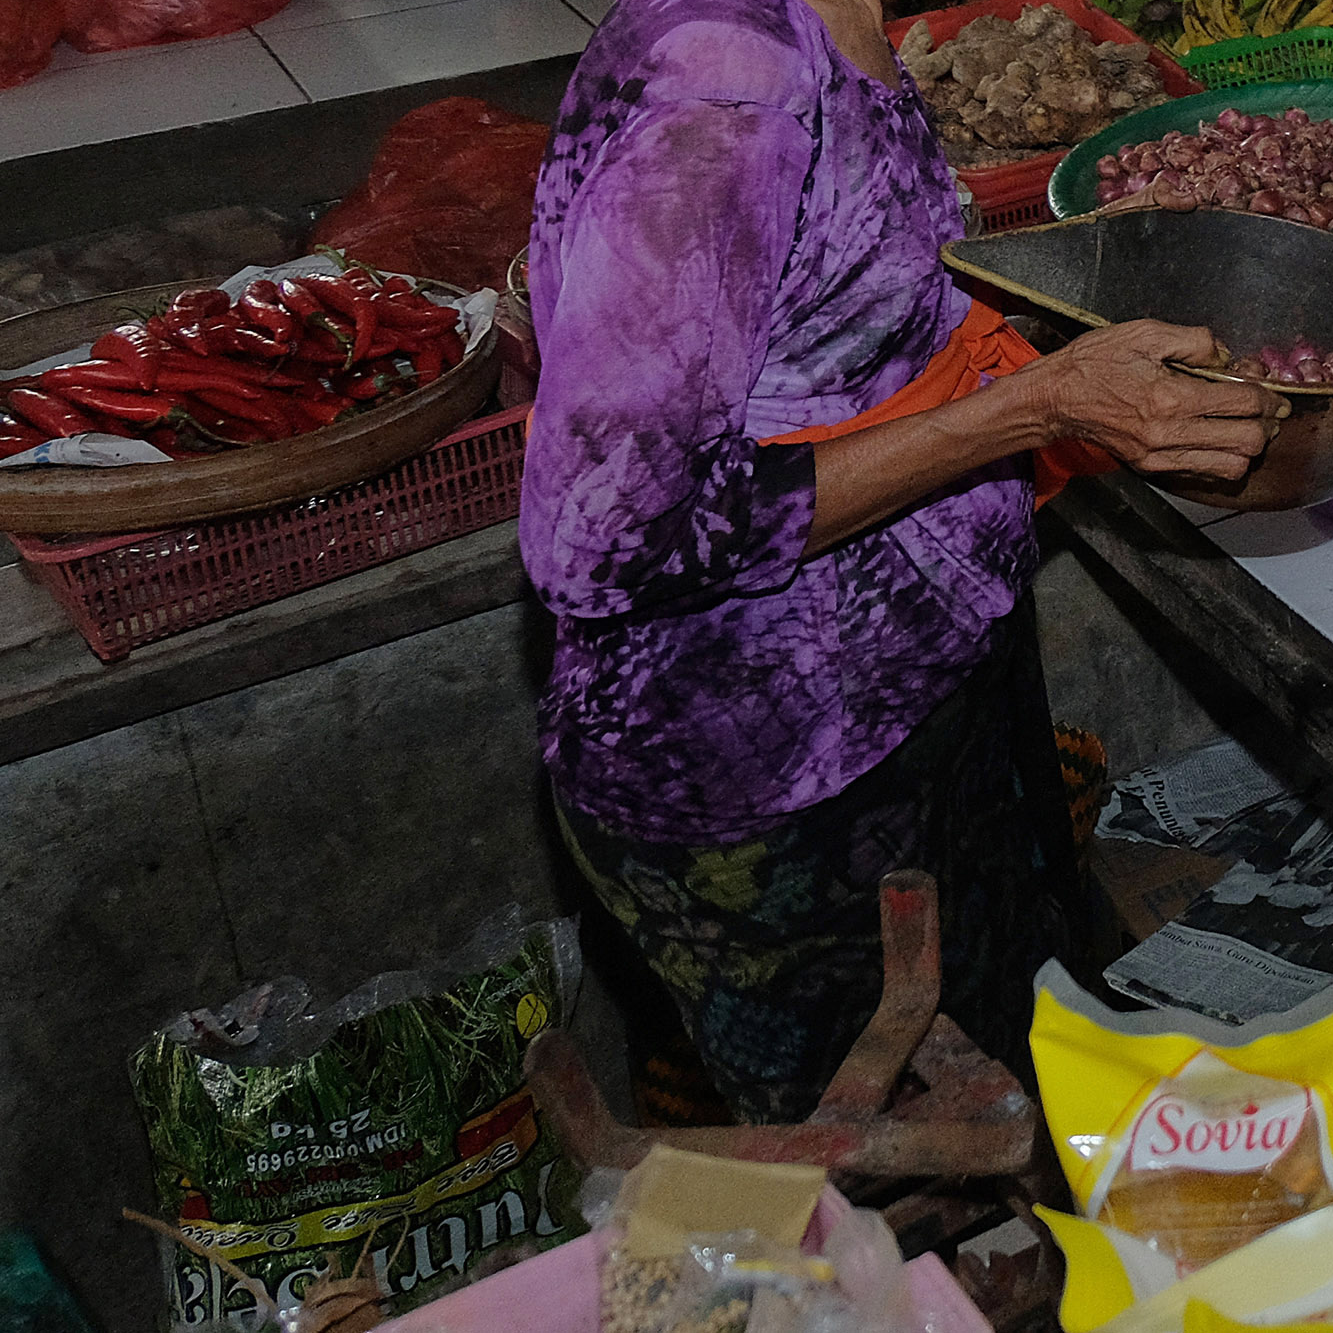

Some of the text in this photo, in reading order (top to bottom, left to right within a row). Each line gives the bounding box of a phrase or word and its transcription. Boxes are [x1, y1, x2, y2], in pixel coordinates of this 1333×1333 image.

[330, 1109, 371, 1138] 25
[364, 1123, 407, 1153] IDM
[1149, 1104, 1295, 1157] Sovia
